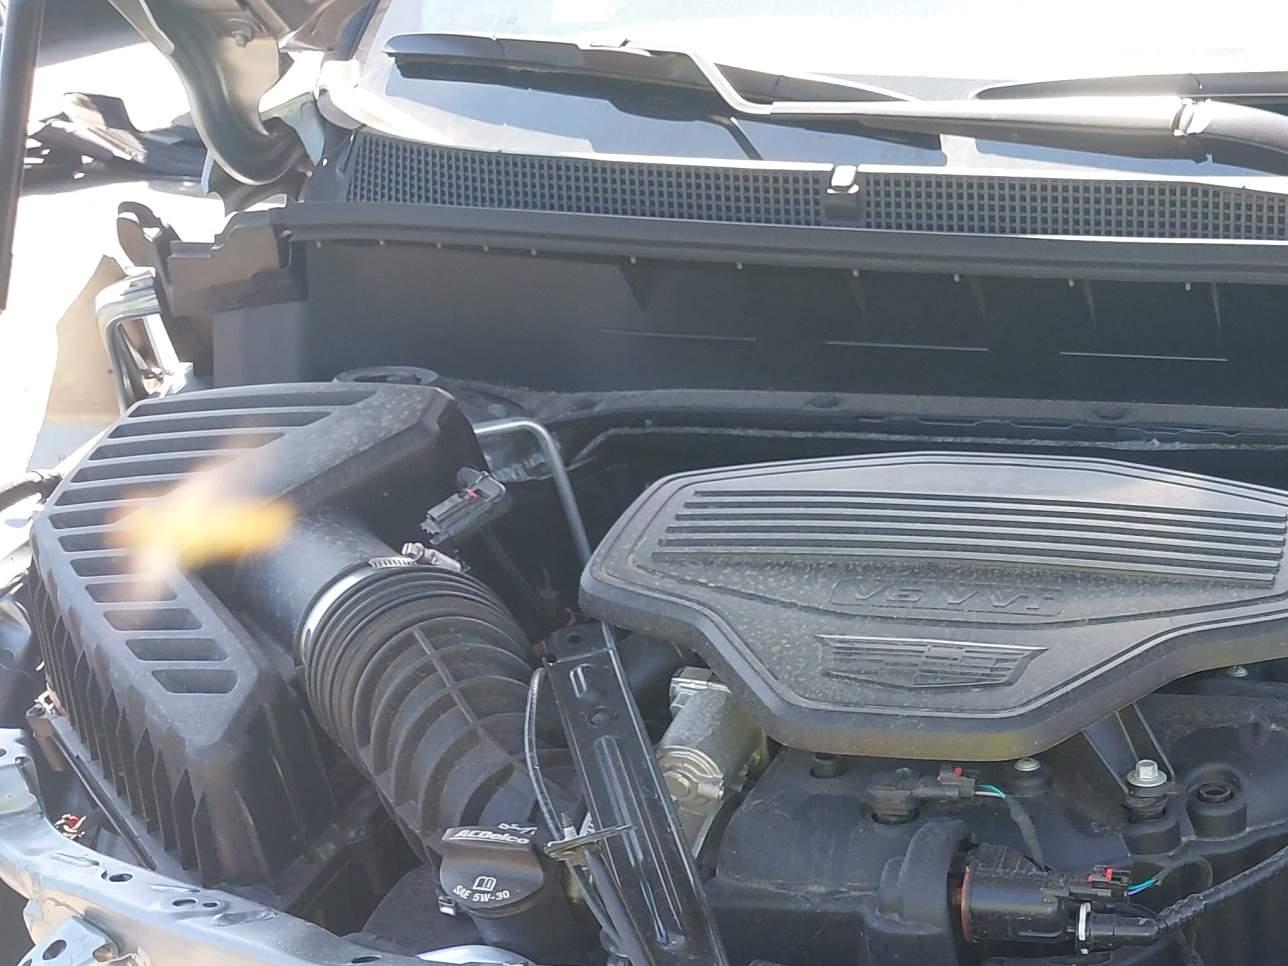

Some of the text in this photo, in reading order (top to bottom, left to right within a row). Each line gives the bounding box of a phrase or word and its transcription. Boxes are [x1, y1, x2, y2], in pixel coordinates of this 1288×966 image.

[454, 829, 530, 844] ACDelco
[453, 884, 511, 903] SAE 5W-30
